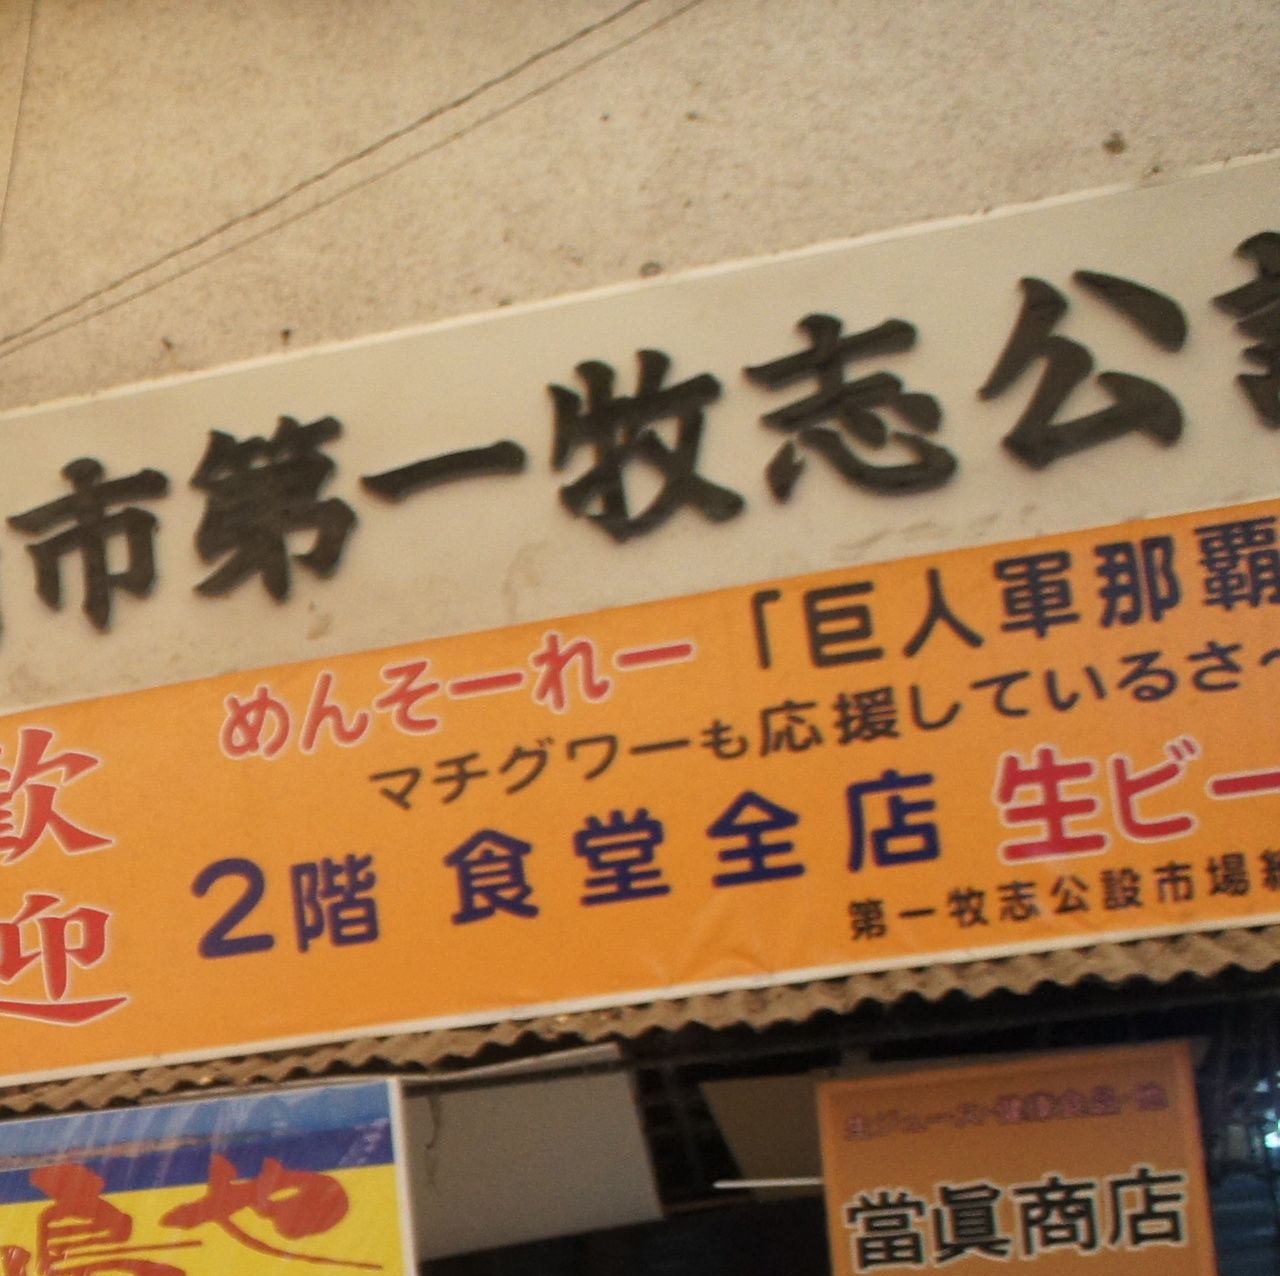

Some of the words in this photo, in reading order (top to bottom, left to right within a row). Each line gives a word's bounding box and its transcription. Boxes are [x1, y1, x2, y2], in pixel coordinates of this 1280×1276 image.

[220, 640, 696, 760] めんそーれー
